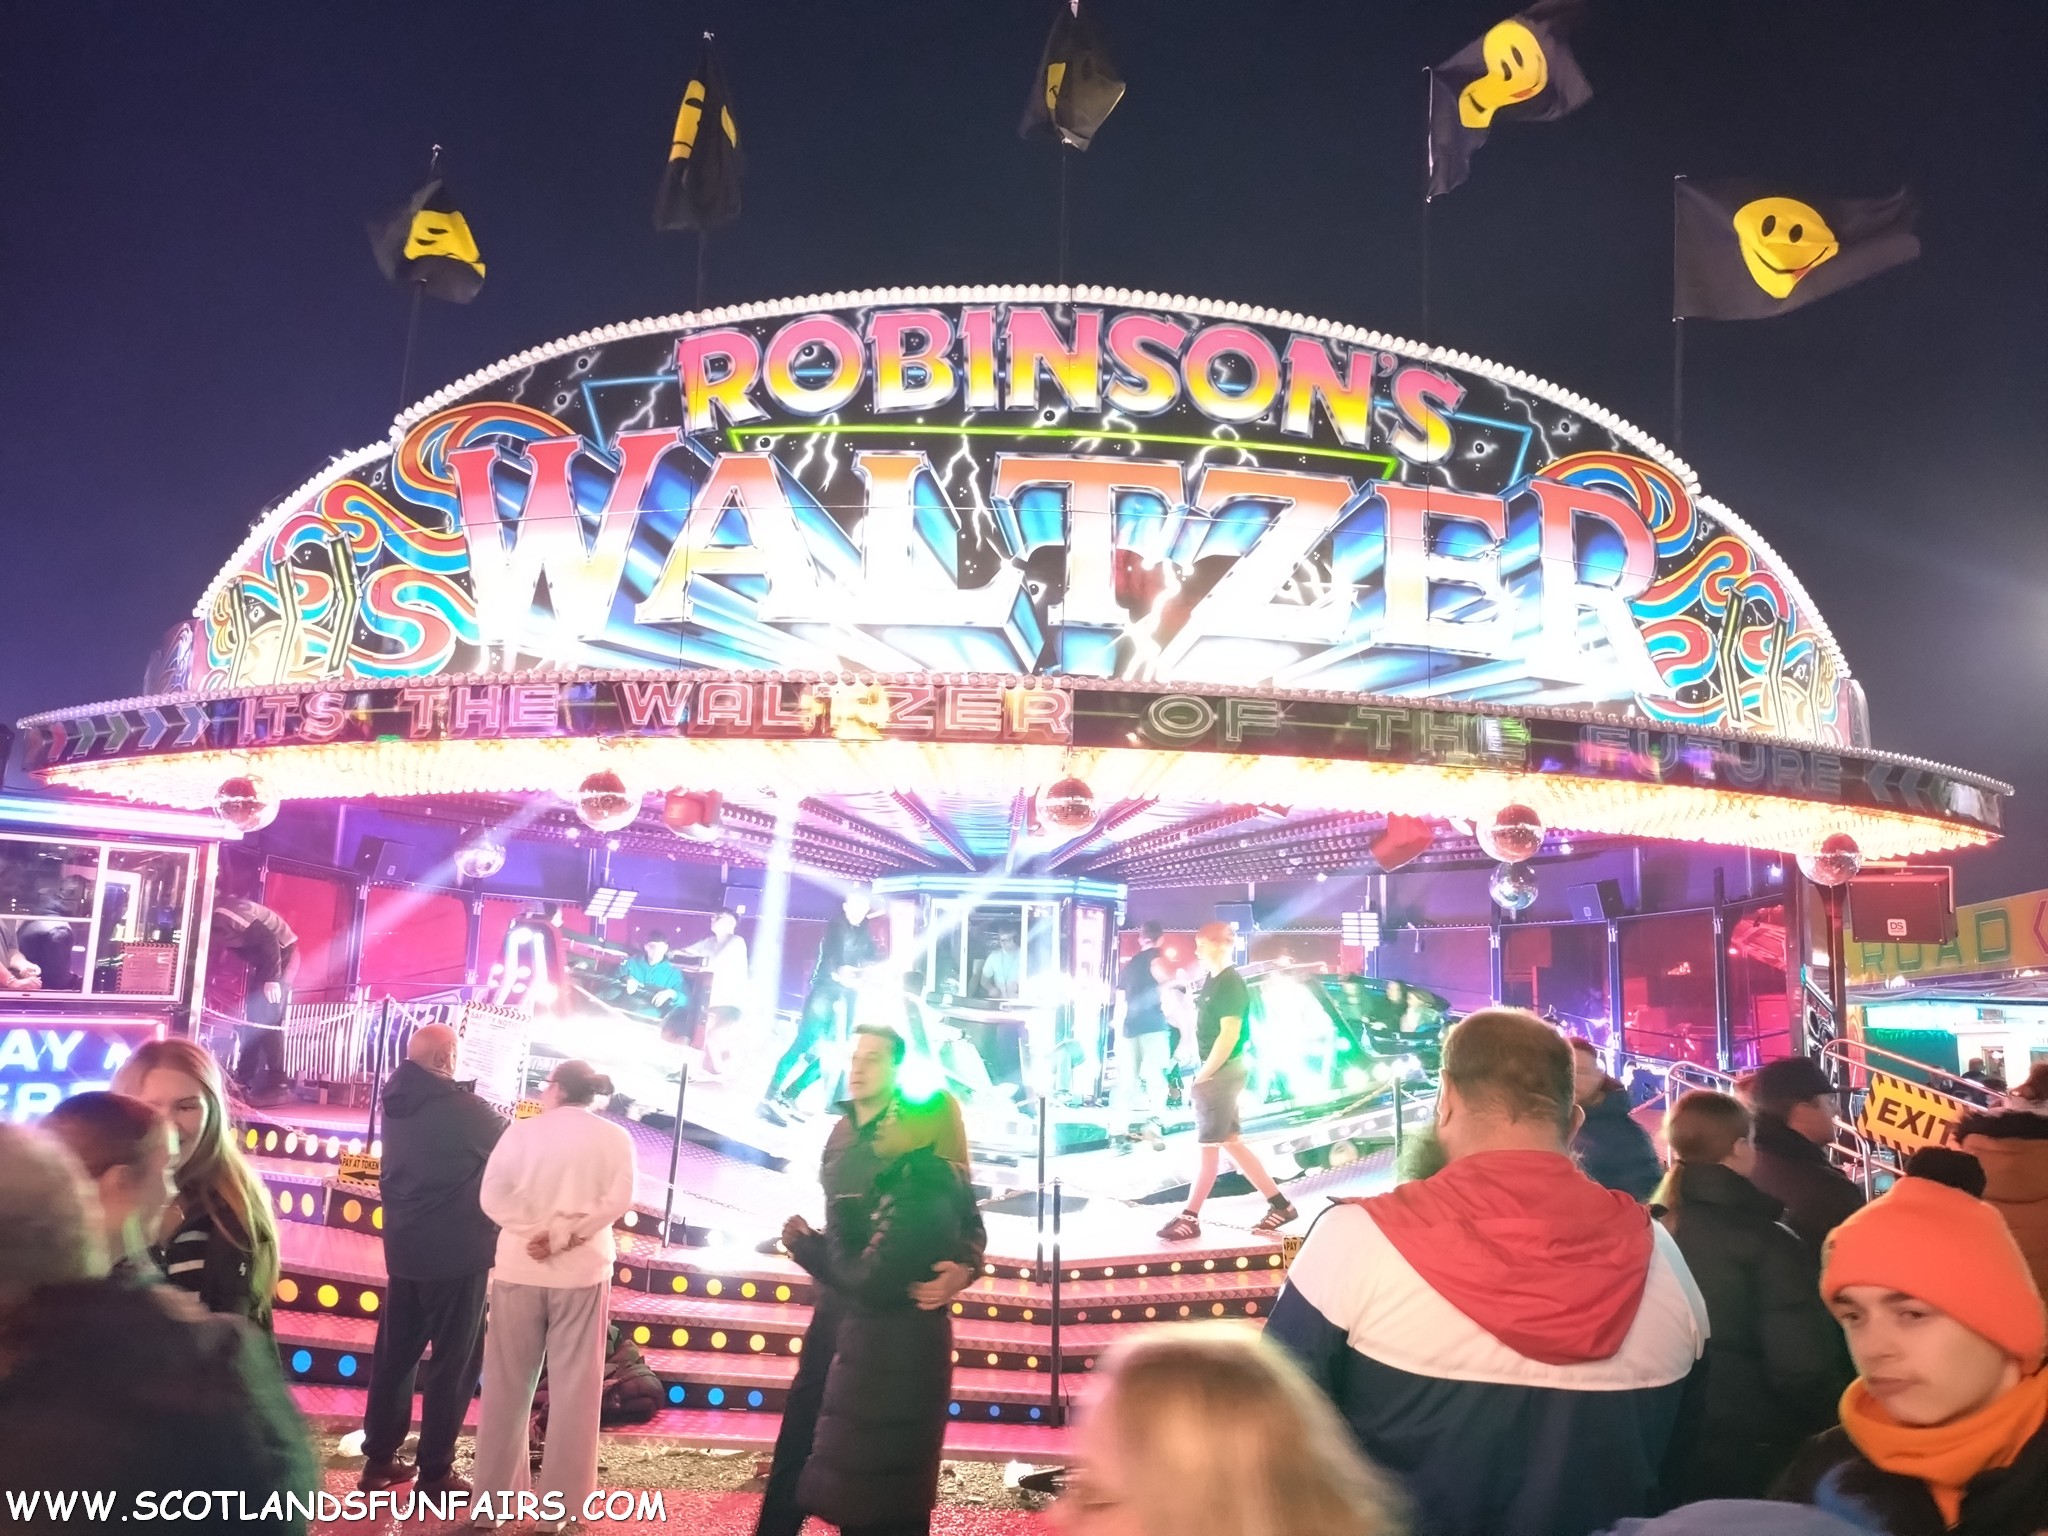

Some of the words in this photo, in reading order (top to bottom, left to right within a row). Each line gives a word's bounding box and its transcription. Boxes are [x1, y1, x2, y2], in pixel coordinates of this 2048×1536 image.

[672, 303, 1468, 466] ROBINSON'S
[446, 426, 1678, 700] WALTZER
[237, 692, 345, 743] ITS
[401, 684, 560, 738] THE
[1142, 694, 1283, 748] OF
[1352, 704, 1527, 764] THE
[1581, 724, 1842, 795] FUTURE
[1890, 922, 1904, 930] DS
[1876, 1097, 1962, 1147] EXIT
[342, 1158, 352, 1167] PAY
[353, 1160, 360, 1168] AT
[362, 1160, 380, 1170] TOKEN
[1286, 1241, 1298, 1251] PAY
